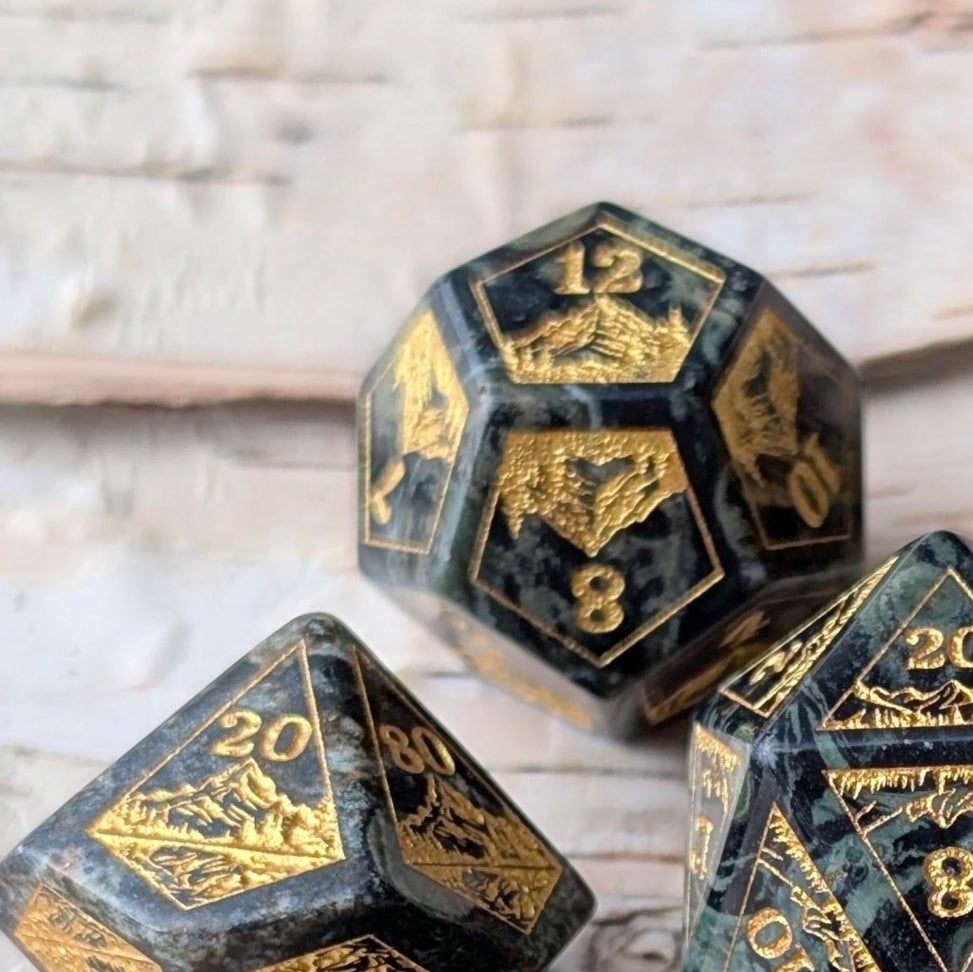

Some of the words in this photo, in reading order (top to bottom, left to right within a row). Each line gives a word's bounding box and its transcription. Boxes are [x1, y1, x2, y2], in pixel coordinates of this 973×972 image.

[554, 240, 643, 294] 12
[788, 432, 840, 528] 10
[571, 564, 625, 633] 8
[211, 710, 314, 763] 20
[379, 725, 456, 776] 80
